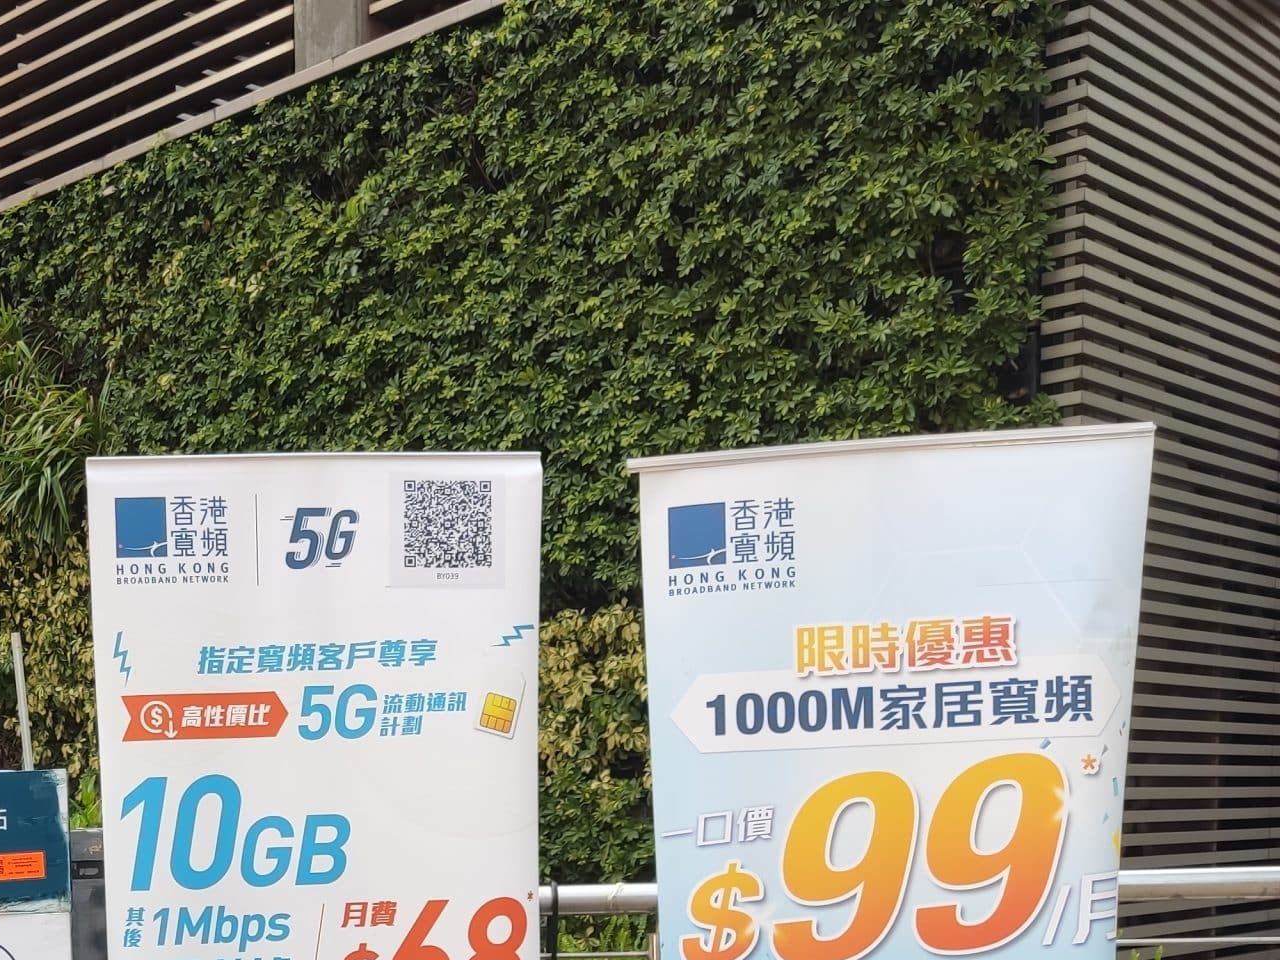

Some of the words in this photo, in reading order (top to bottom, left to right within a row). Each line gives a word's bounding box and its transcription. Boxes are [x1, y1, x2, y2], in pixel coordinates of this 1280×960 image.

[170, 496, 227, 527] 香港
[730, 498, 795, 531] 香港
[171, 528, 228, 557] 寬頻
[285, 507, 360, 570] 5G
[730, 531, 796, 564] 寬頻
[116, 563, 166, 576] HONG
[178, 562, 229, 574] KONG
[116, 576, 177, 585] BROADBAND
[183, 575, 229, 584] NETWORK
[668, 570, 725, 587] HONG
[738, 566, 797, 581] KONG
[668, 582, 737, 597] BROADBAND
[743, 579, 796, 591] NETWORK
[197, 638, 438, 676] 指定寬頻客戶尊享
[795, 615, 1015, 674] 限時優惠
[181, 704, 271, 729] 高性價比
[298, 684, 377, 742] 5G
[383, 692, 468, 713] 流動通訊
[706, 674, 1094, 736] 1000M家居寬頻
[379, 716, 423, 737] 計劃
[120, 774, 351, 891] 10GB
[661, 805, 775, 847] 一口價
[153, 906, 290, 952] 1Mbps
[341, 901, 398, 928] 月費
